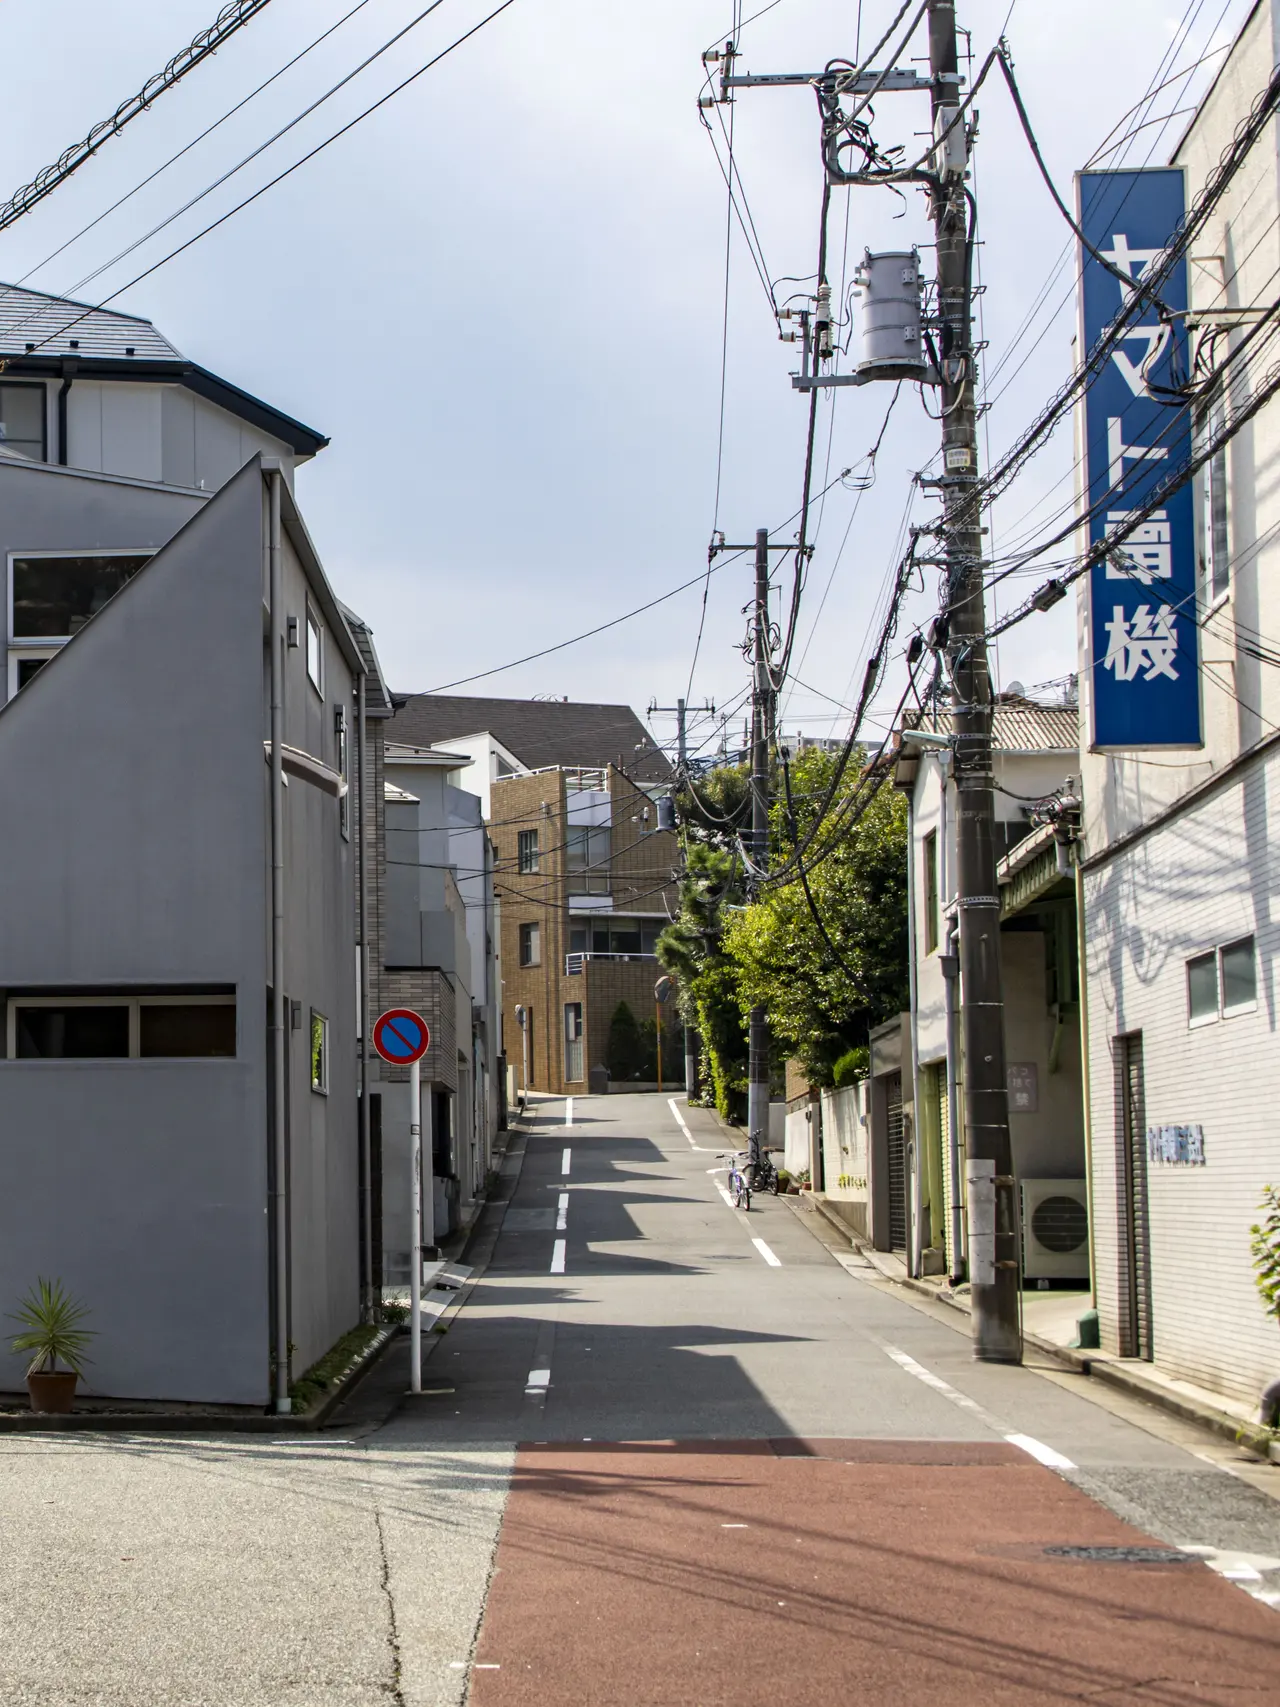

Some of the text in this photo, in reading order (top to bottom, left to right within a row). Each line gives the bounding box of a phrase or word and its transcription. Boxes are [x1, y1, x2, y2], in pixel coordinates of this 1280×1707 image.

[1095, 233, 1180, 682] ヤマト電機
